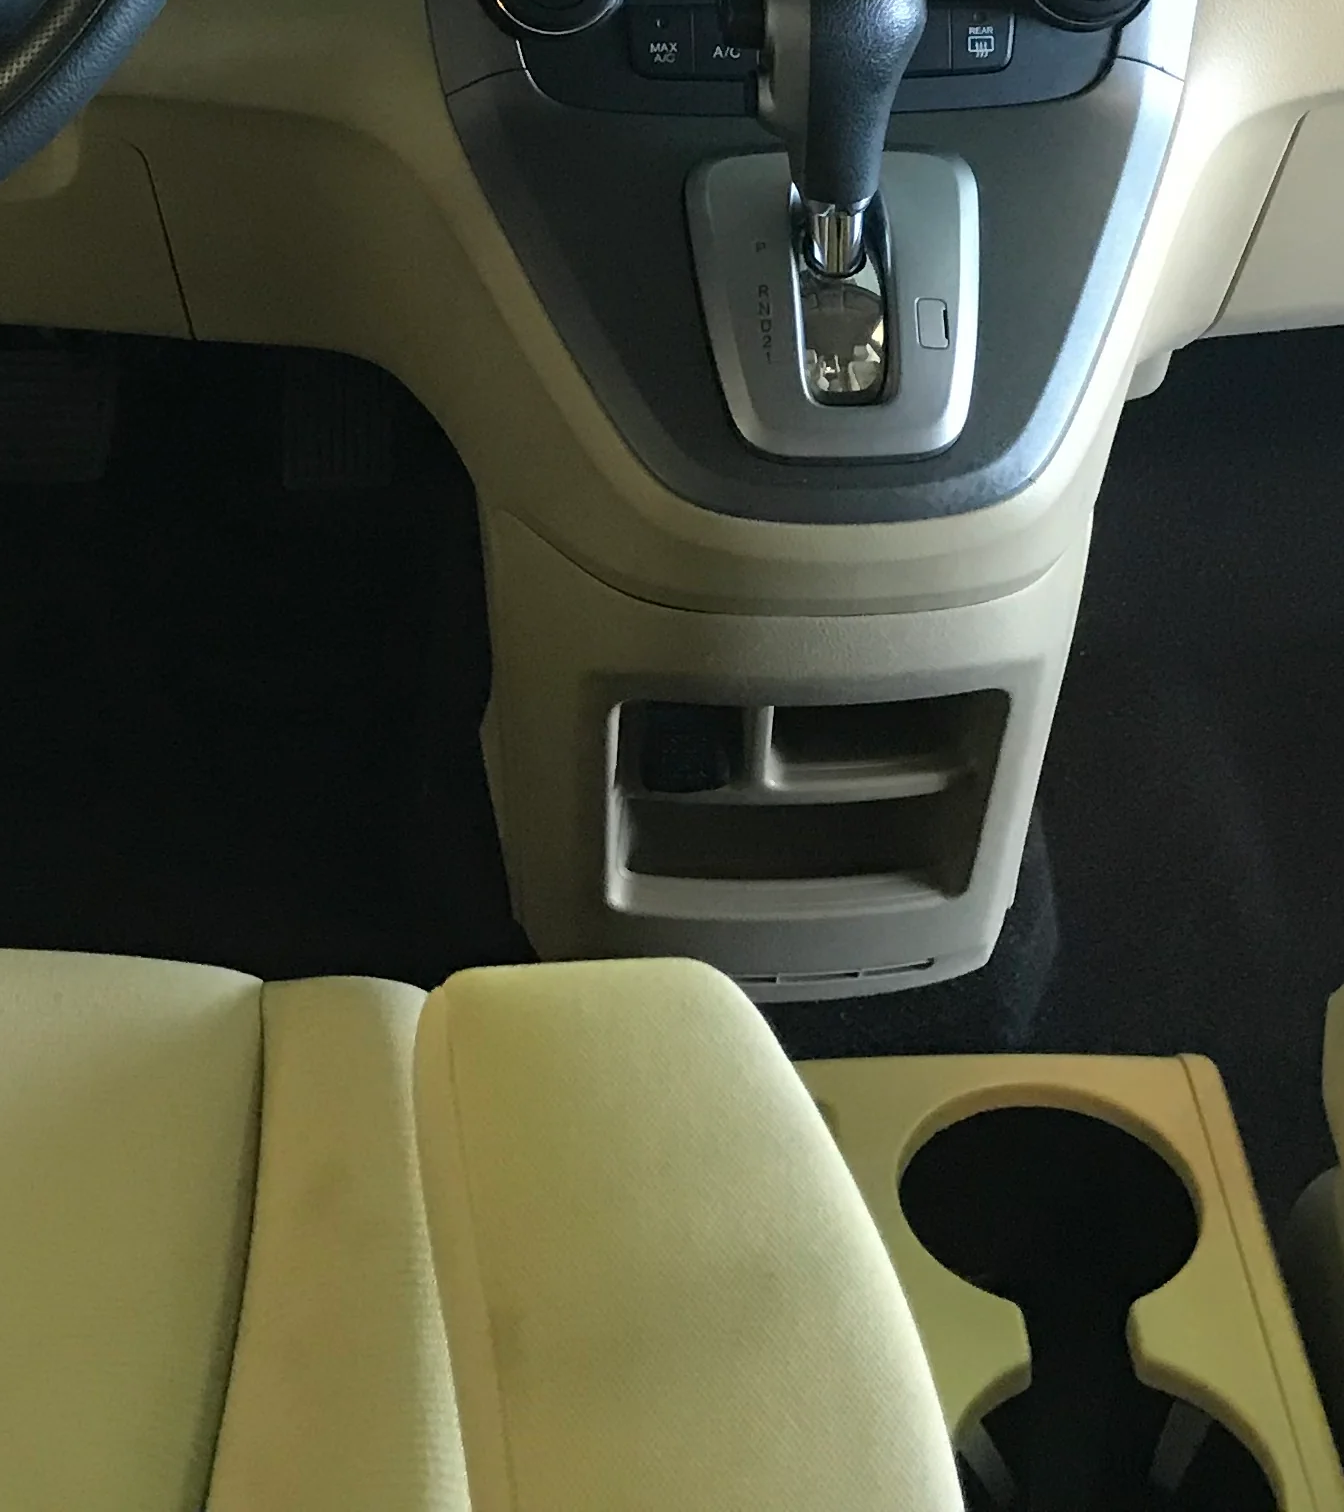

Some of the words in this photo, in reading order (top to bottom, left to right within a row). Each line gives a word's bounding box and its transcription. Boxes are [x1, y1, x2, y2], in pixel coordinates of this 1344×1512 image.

[968, 25, 994, 35] REAR
[648, 41, 679, 54] MAX
[711, 45, 742, 60] A/C
[653, 52, 677, 64] A/C
[755, 240, 767, 253] P
[758, 283, 770, 299] R
[758, 301, 771, 317] N
[760, 318, 773, 334] D
[762, 334, 773, 349] 2
[765, 350, 772, 365] 1
